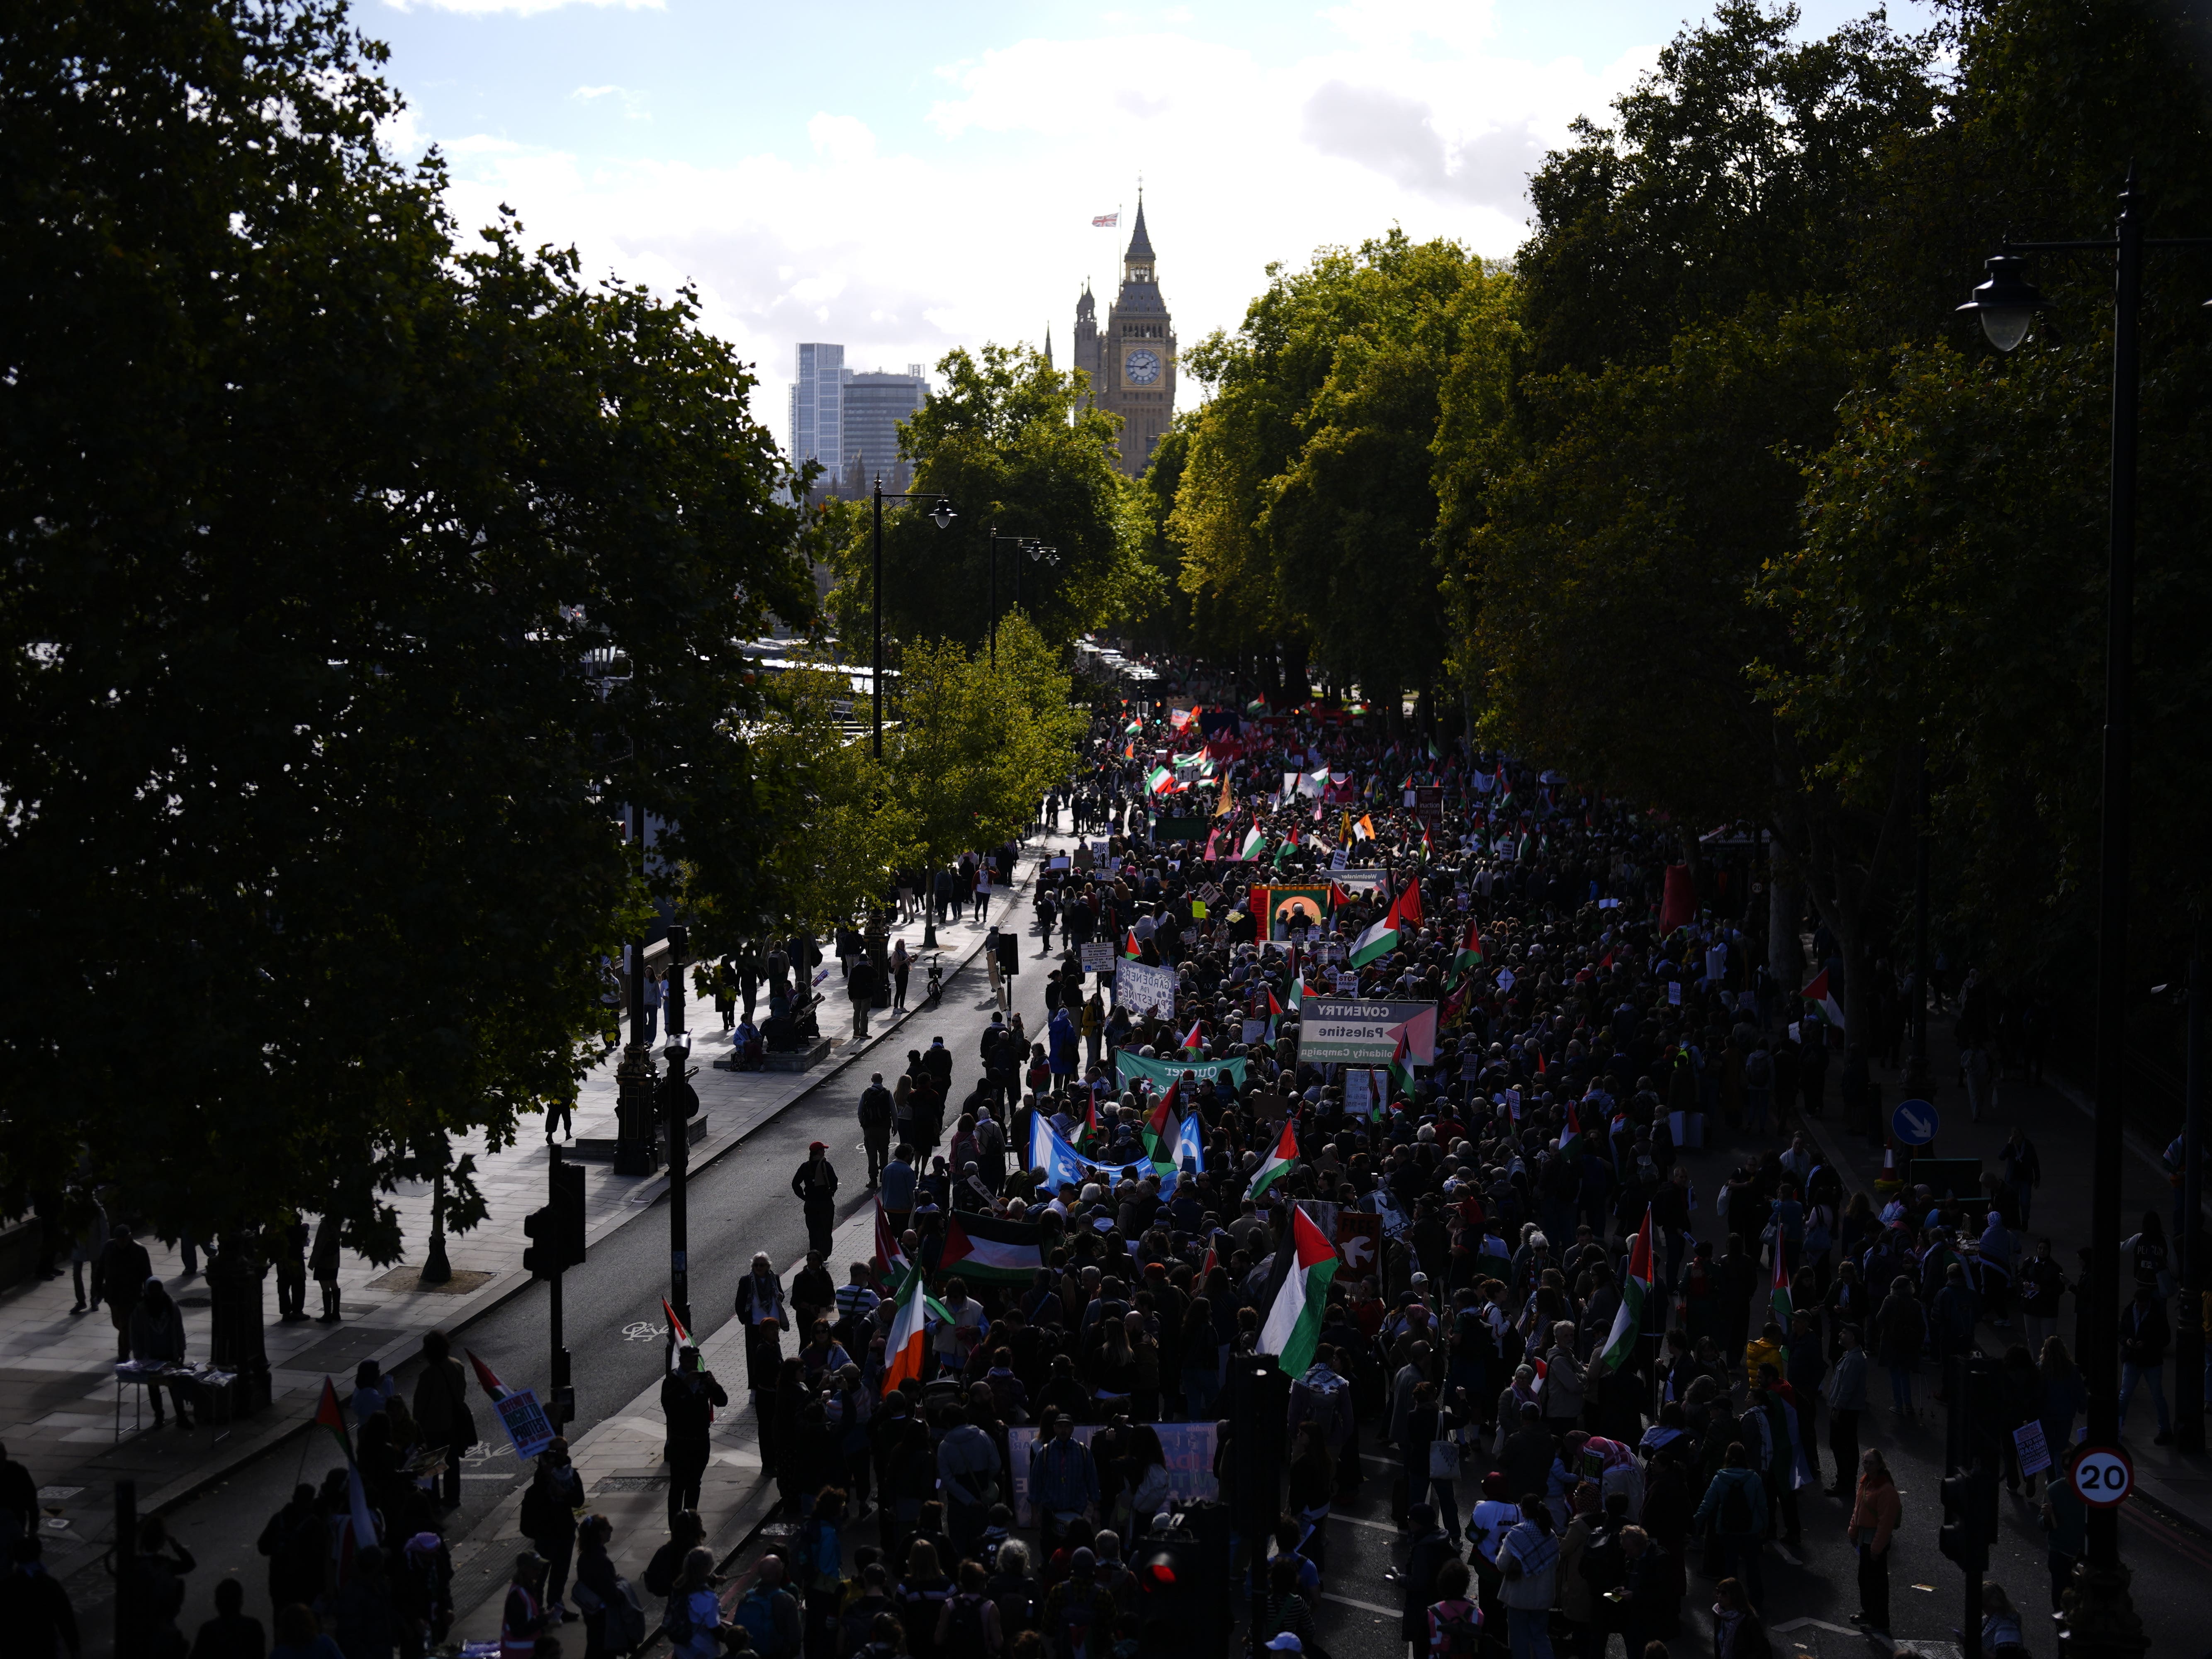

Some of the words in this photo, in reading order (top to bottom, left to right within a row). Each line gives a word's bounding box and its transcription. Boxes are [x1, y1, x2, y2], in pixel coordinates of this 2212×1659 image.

[1201, 885, 1210, 894] Stop
[1341, 1218, 1374, 1235] FREE
[1384, 1222, 1408, 1237] GAZA
[503, 1406, 530, 1428] RIGHT
[528, 1401, 542, 1418] TO
[511, 1415, 549, 1443] PROTEST
[2032, 1434, 2044, 1443] WAR
[2018, 1439, 2046, 1456] RACISM
[2022, 1450, 2048, 1464] CAPITALISM
[2081, 1465, 2124, 1490] 20
